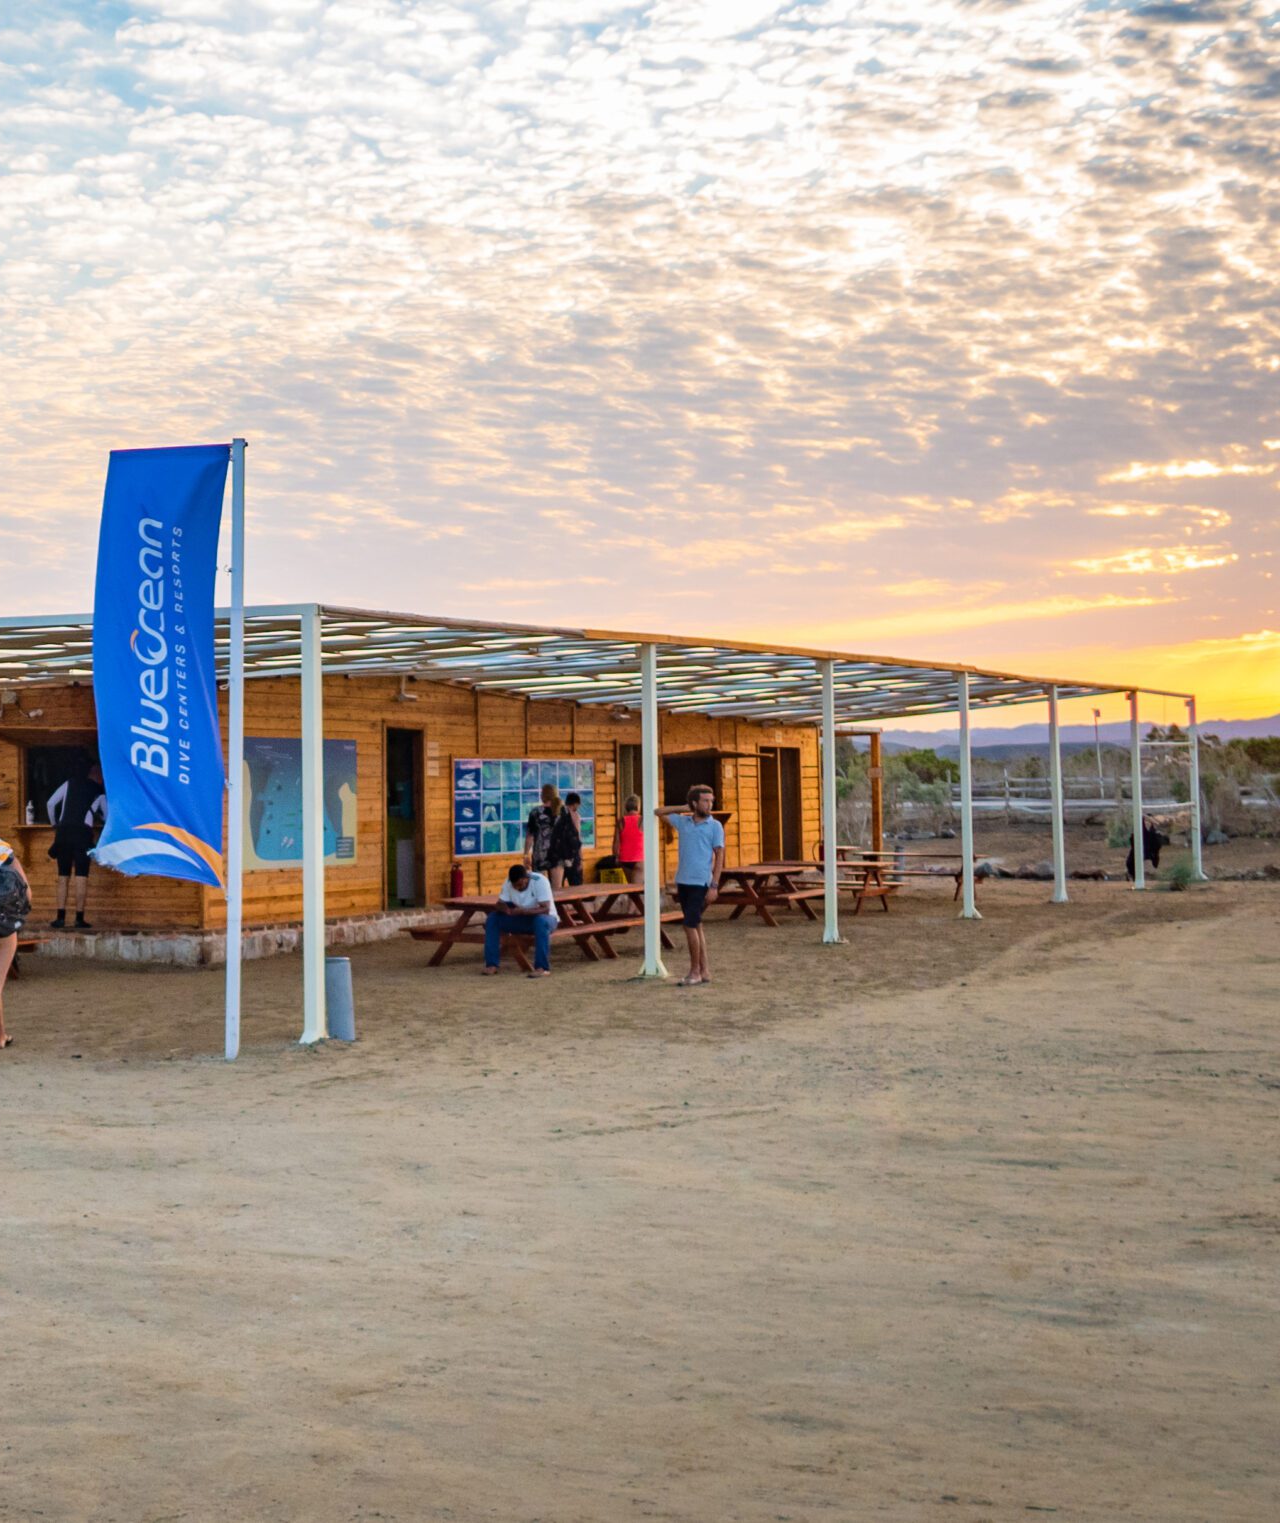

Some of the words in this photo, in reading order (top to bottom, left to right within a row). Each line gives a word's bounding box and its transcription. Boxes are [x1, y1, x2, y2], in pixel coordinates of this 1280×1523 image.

[171, 526, 184, 613] RESORTS
[129, 517, 169, 778] BlueOcean
[174, 624, 186, 635] &
[174, 643, 189, 730] CENTERS
[178, 738, 191, 785] DIVE
